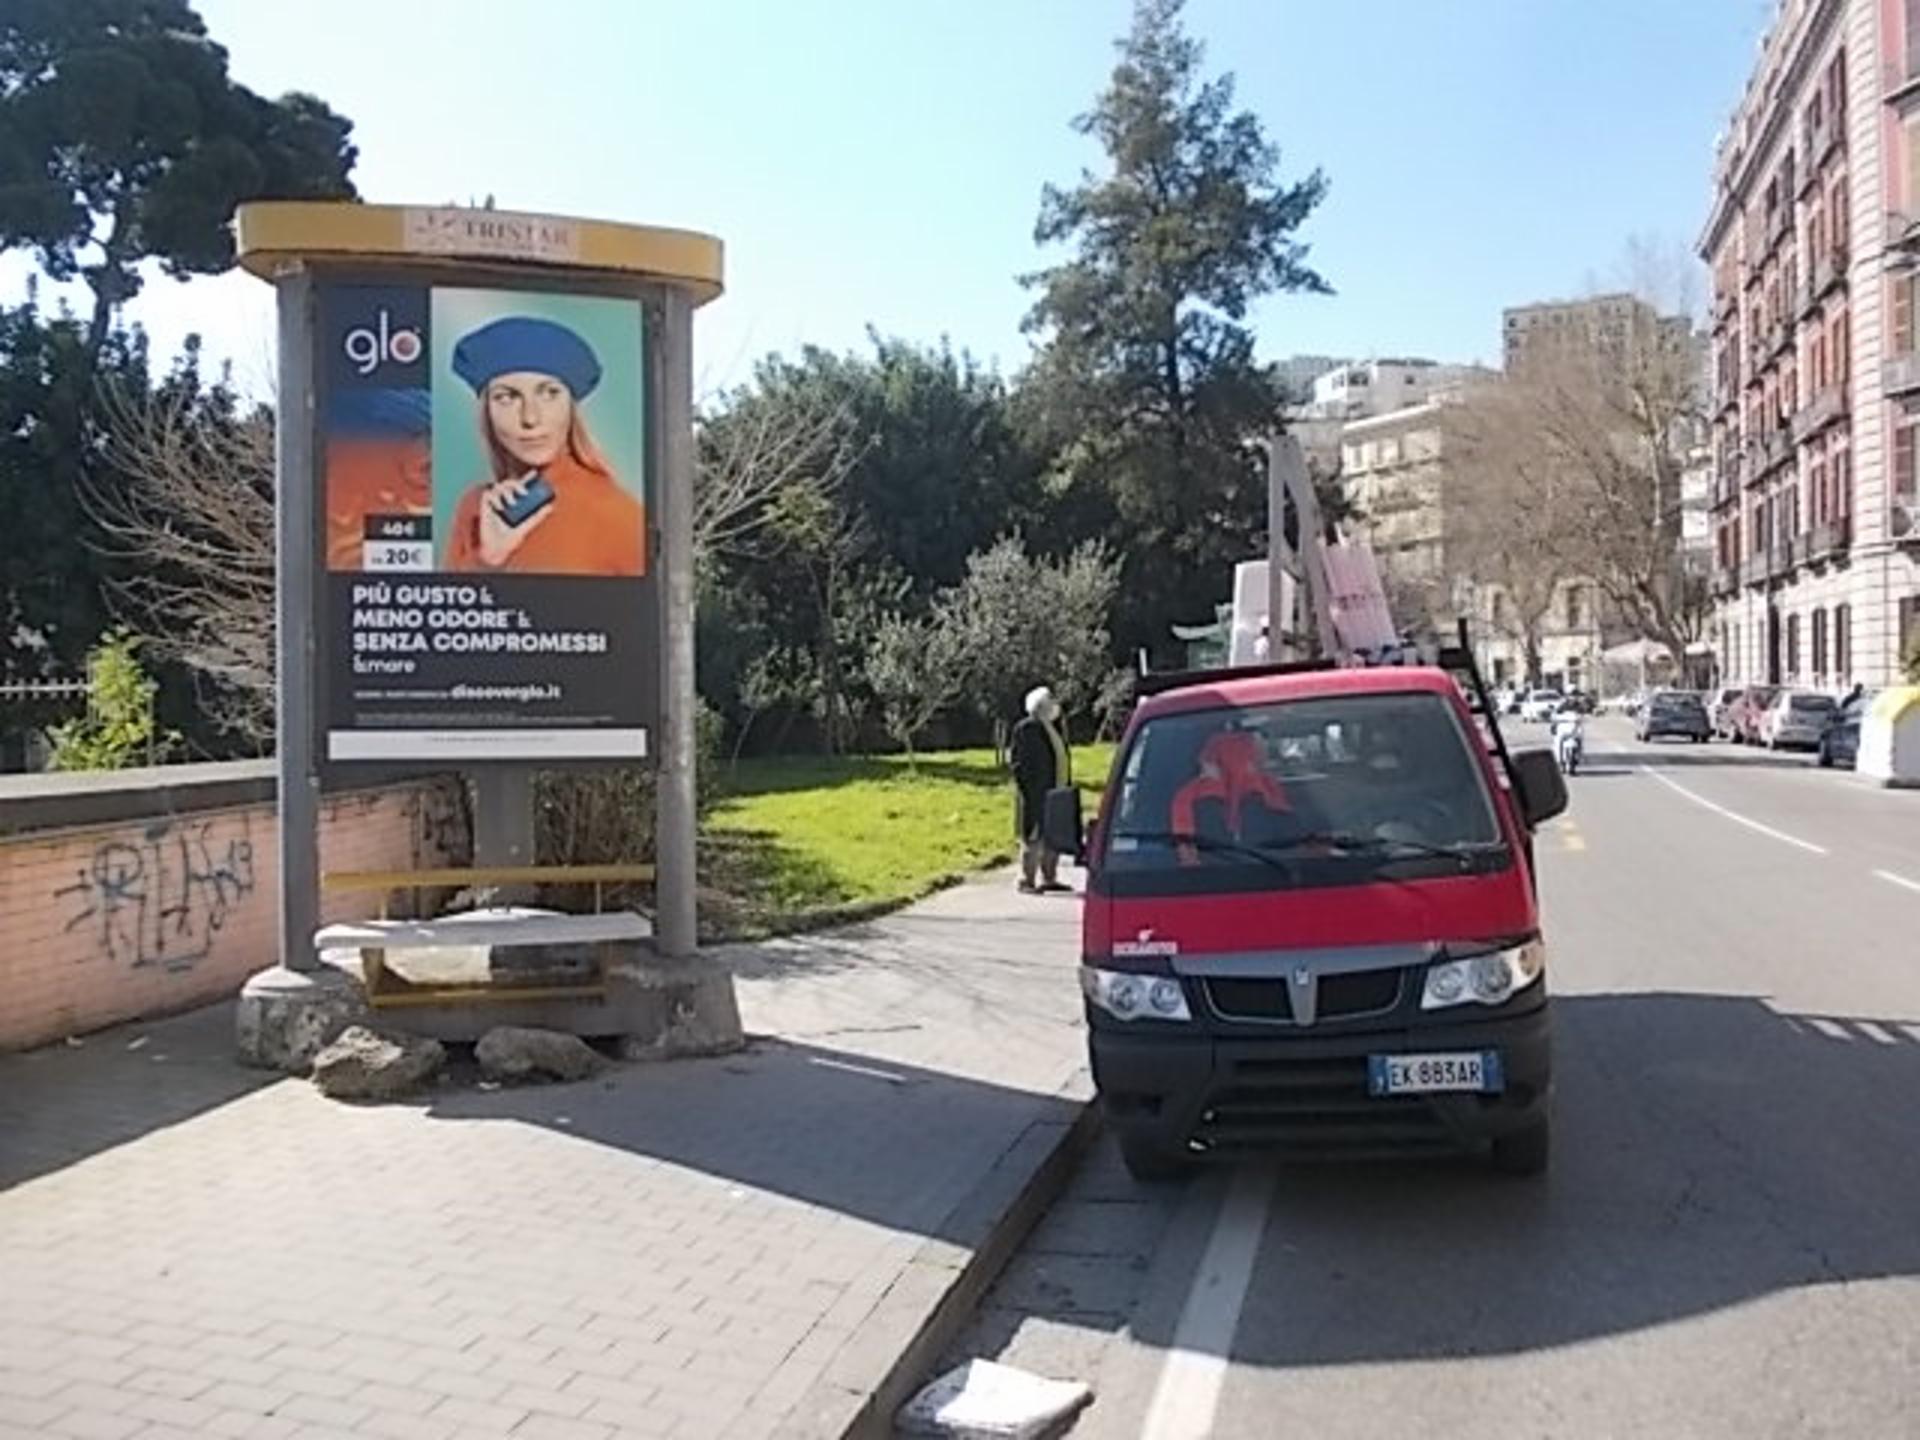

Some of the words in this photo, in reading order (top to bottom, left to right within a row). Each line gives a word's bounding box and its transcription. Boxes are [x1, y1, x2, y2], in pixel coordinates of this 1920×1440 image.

[344, 310, 421, 374] glo
[385, 548, 422, 567] 20€
[353, 581, 391, 605] PIÙ
[395, 585, 477, 606] GUSTO
[353, 608, 424, 628] MENO
[353, 632, 429, 652] SENZA
[433, 631, 607, 653] COMPROMESSI
